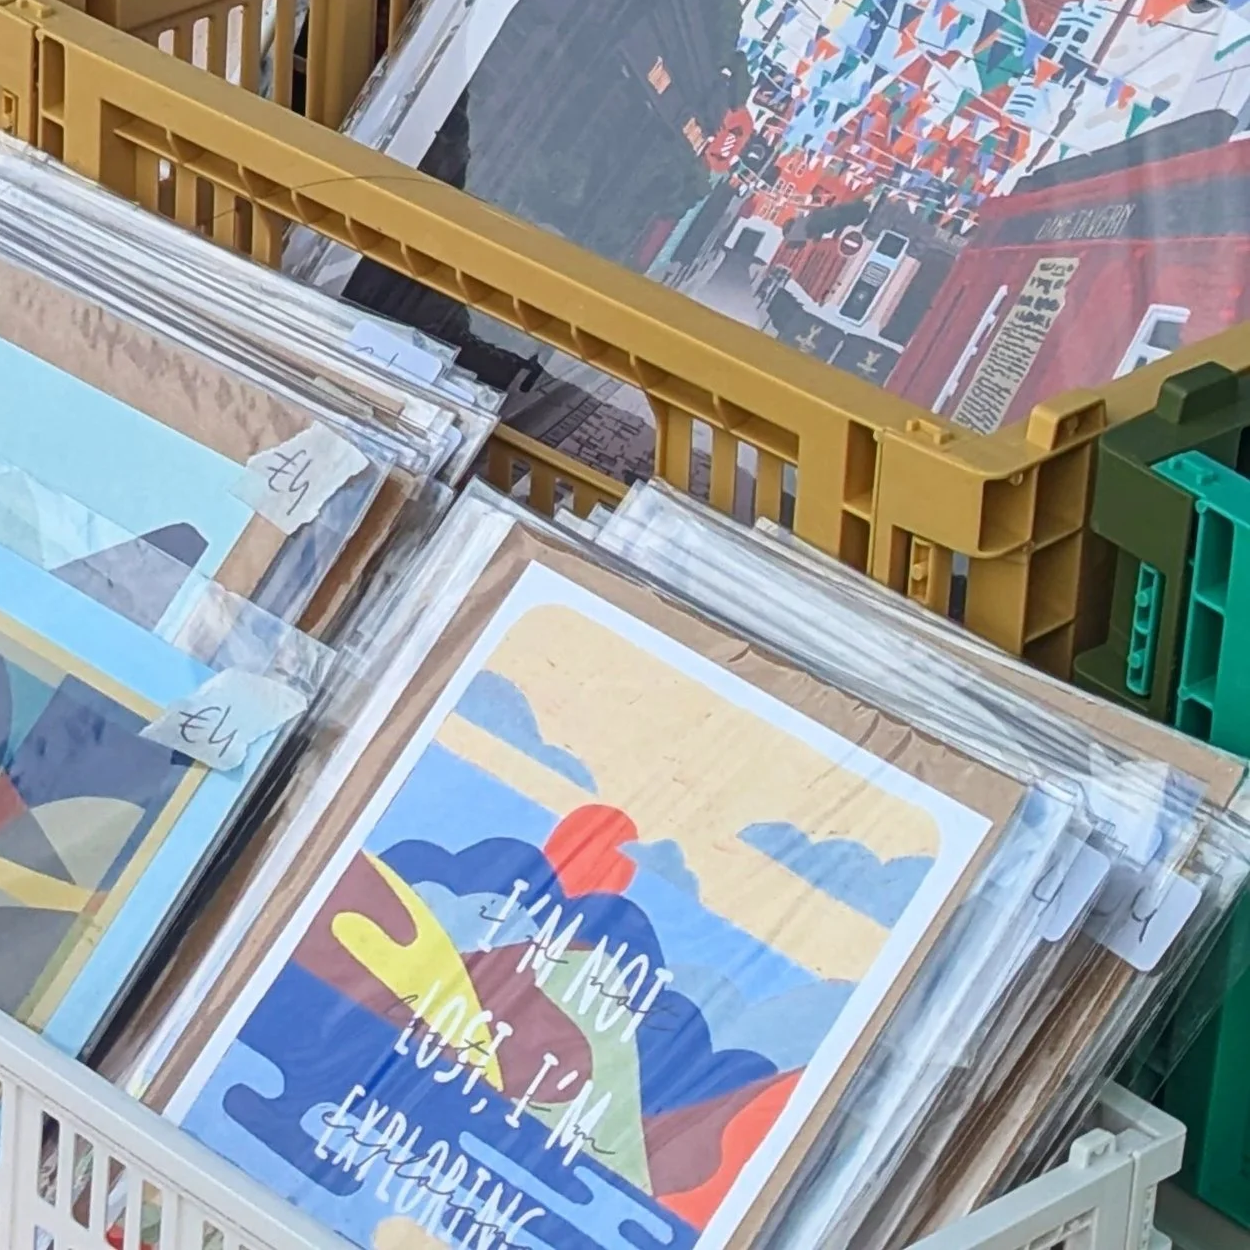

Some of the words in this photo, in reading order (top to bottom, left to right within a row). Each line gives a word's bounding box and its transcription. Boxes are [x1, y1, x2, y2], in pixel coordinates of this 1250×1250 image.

[266, 449, 313, 516] €4
[179, 705, 238, 758] €4
[477, 879, 585, 988] I'M
[562, 934, 675, 1043] NOT
[504, 1052, 613, 1165] I'M
